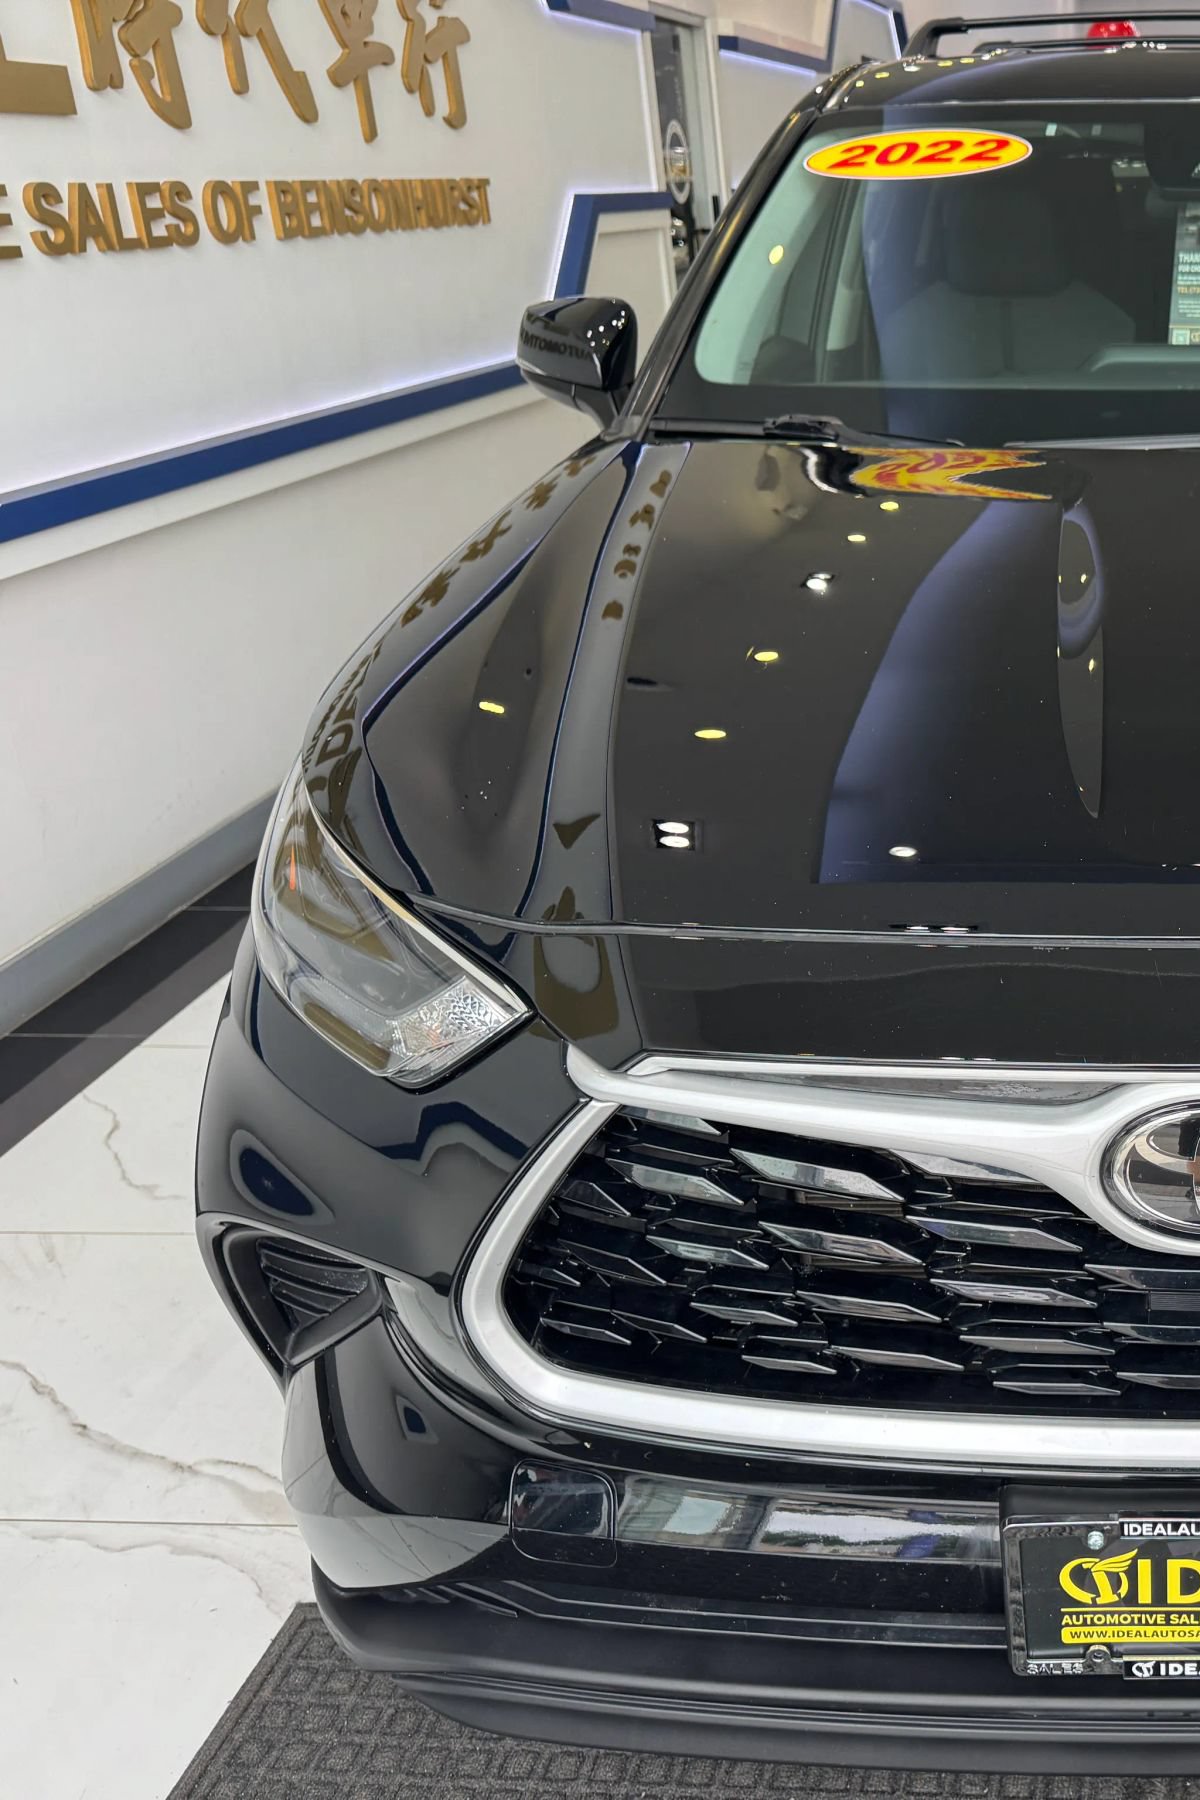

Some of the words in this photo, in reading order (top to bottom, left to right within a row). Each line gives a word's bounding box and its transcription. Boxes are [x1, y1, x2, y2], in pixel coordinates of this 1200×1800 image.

[826, 139, 1011, 170] 2022
[22, 181, 199, 256] SALES
[203, 180, 262, 244] OF
[266, 178, 491, 241] BENSONHURST
[1061, 1613, 1166, 1625] AUTOMOTIVE
[1026, 1663, 1084, 1675] SALES
